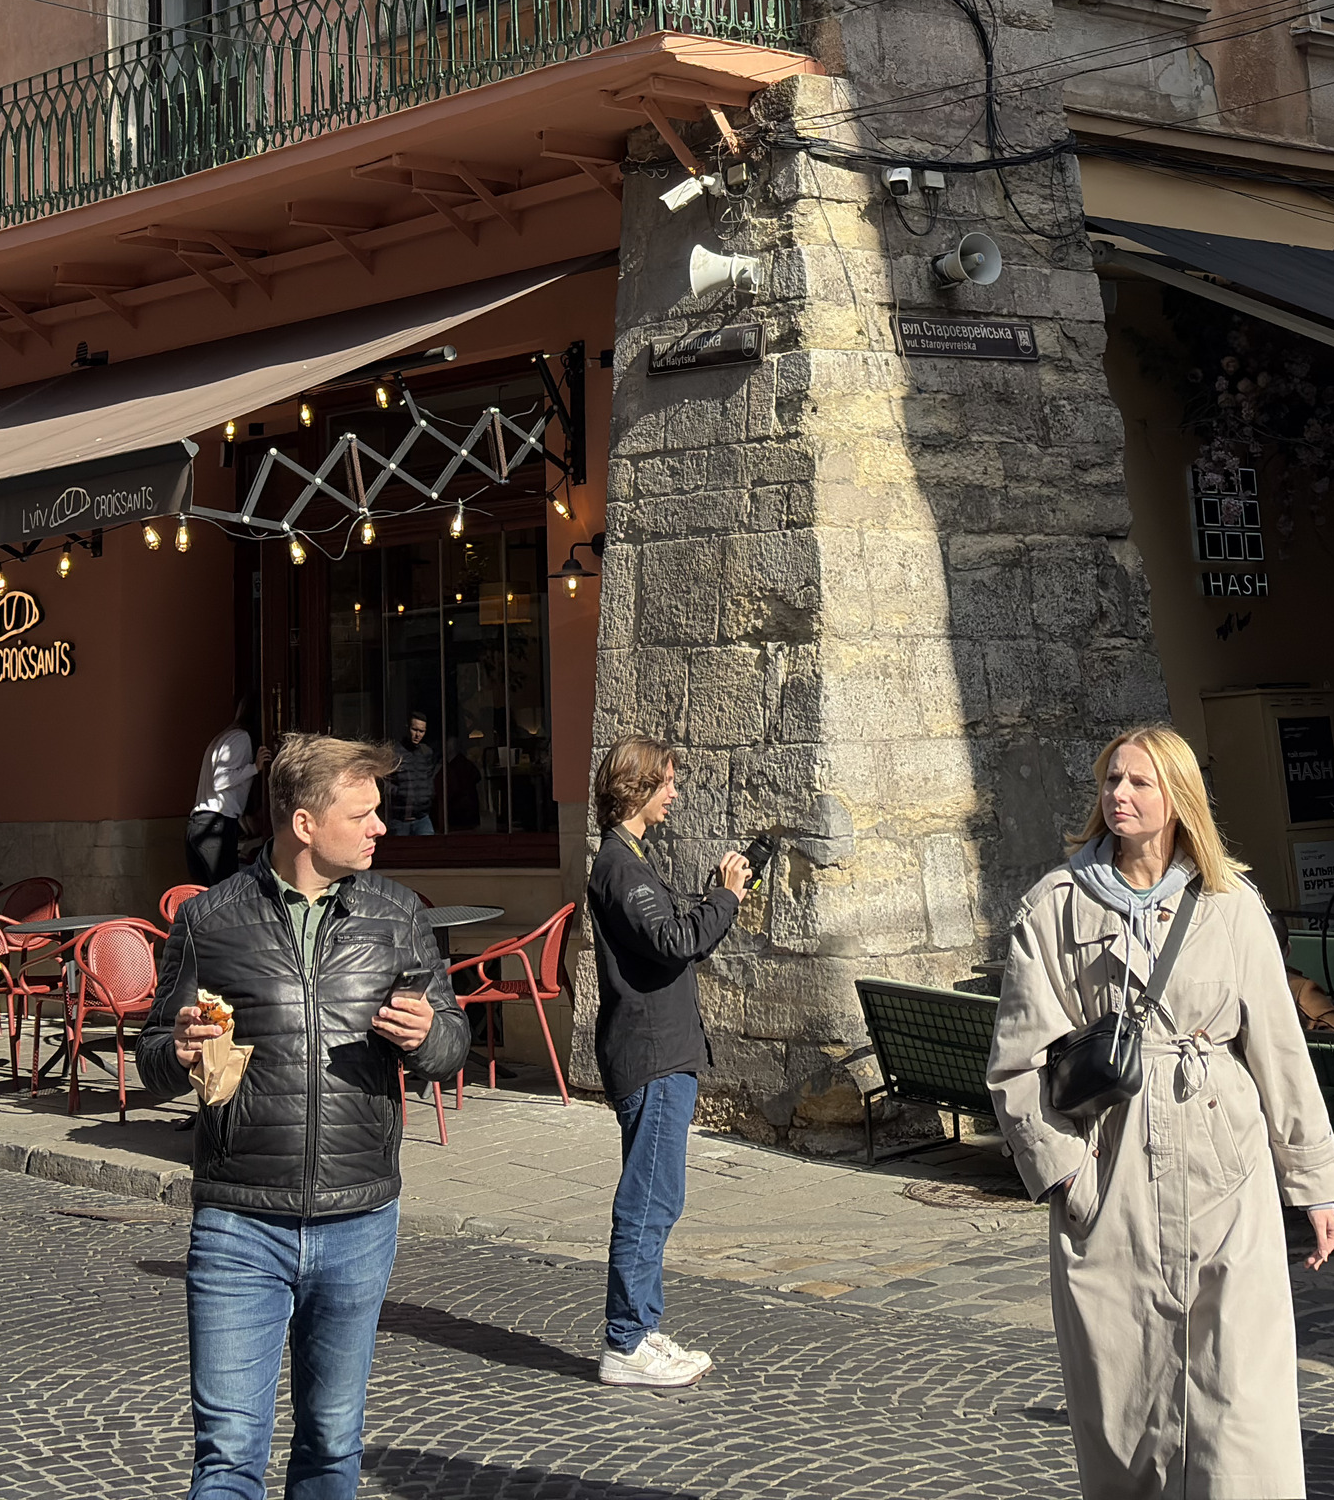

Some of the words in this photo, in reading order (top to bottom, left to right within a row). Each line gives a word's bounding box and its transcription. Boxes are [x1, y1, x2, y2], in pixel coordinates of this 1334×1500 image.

[921, 339, 977, 351] Staroyevreiska
[666, 355, 697, 367] Halytska
[1209, 572, 1269, 597] HASH
[1287, 759, 1334, 782] HASH
